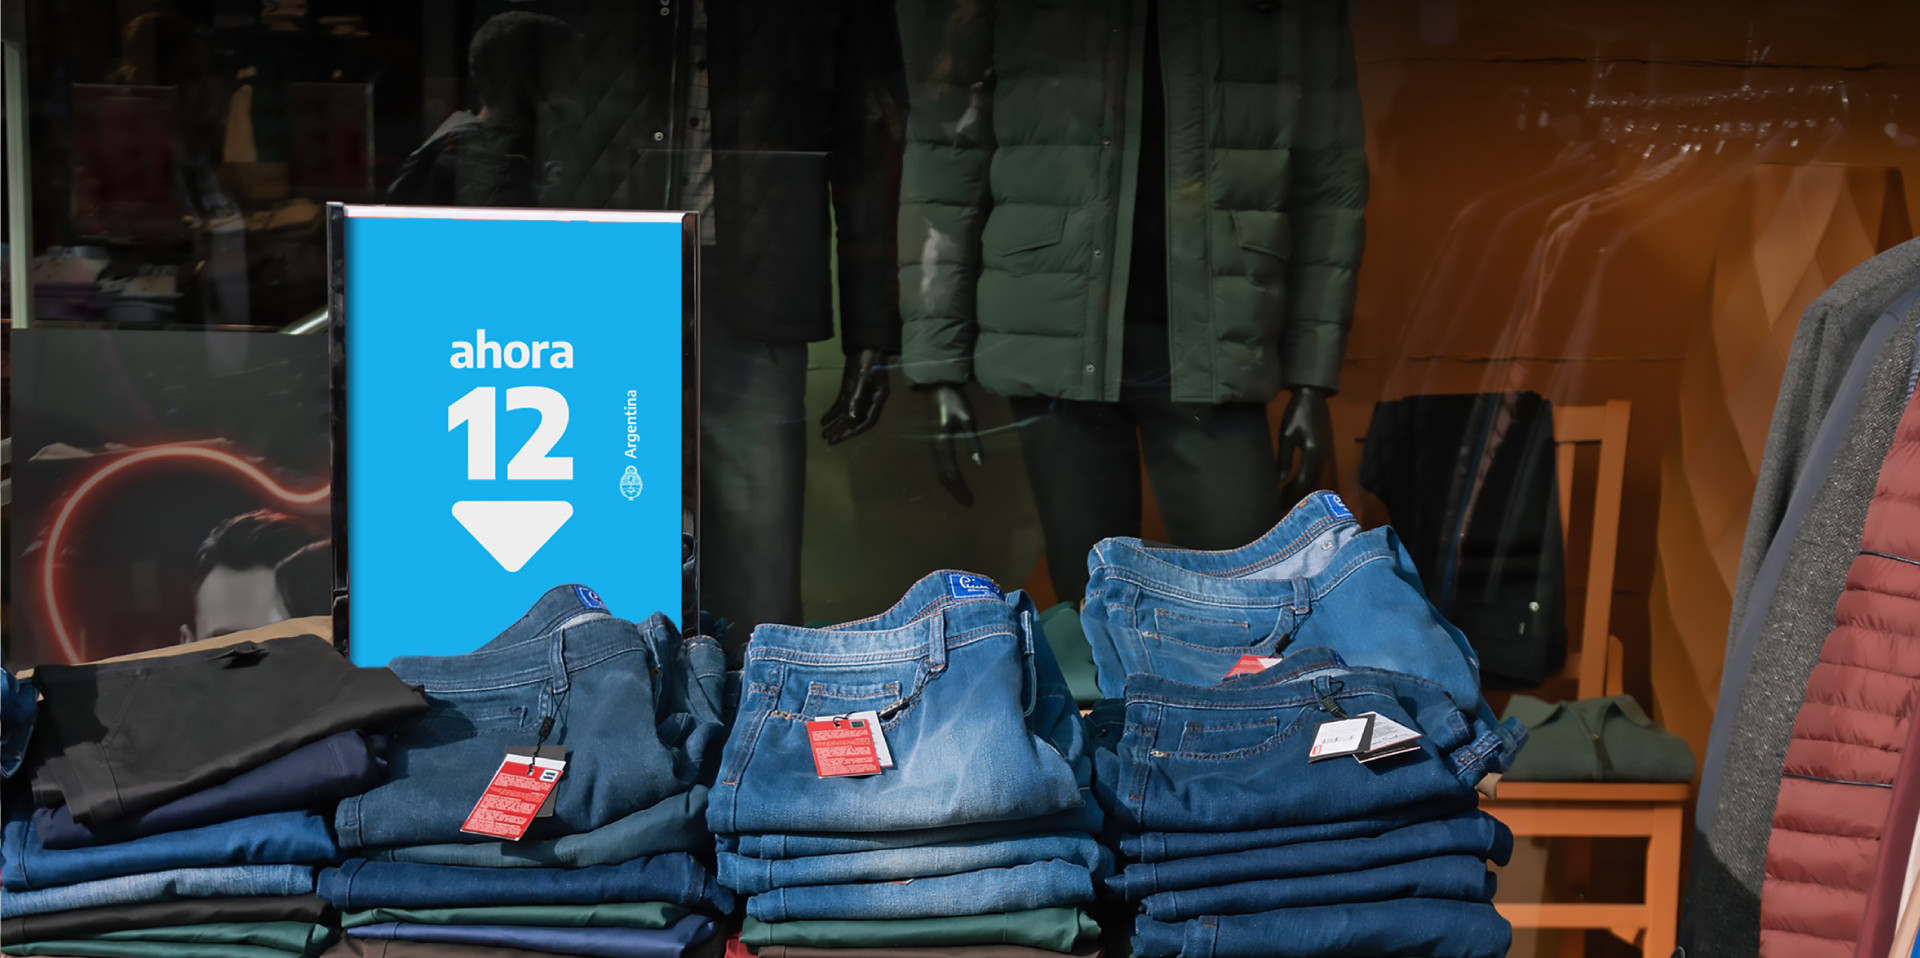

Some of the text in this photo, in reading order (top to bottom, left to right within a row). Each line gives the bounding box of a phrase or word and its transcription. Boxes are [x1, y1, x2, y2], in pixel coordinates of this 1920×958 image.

[450, 329, 573, 368] ahora
[448, 386, 573, 480] 12
[623, 389, 640, 459] Argentina
